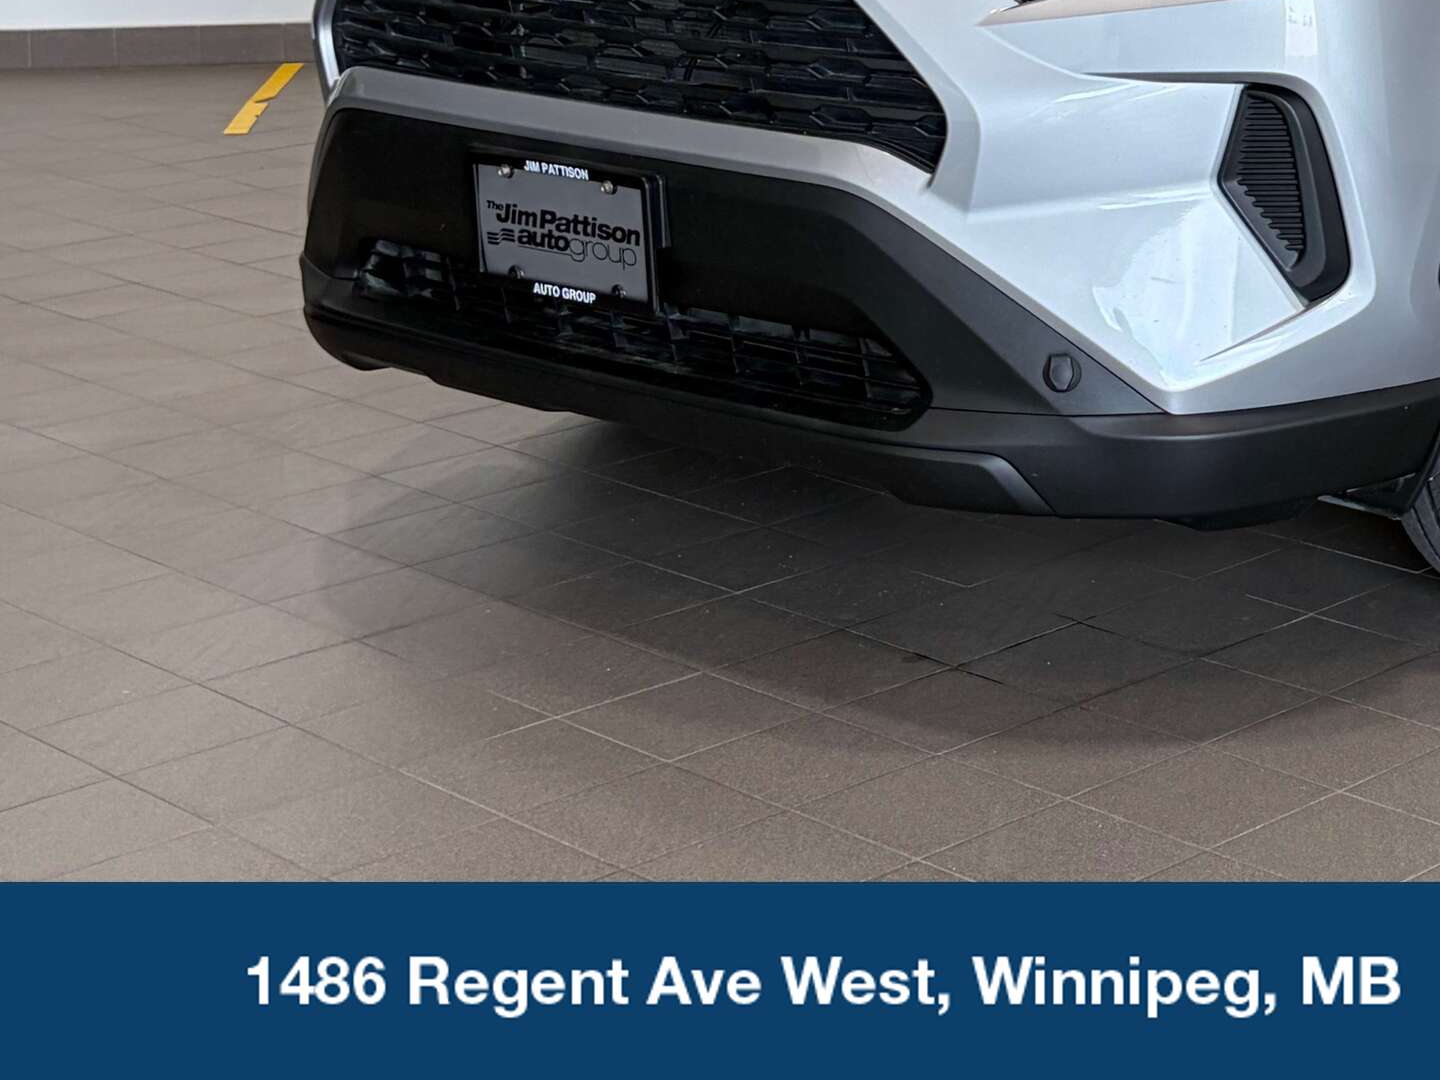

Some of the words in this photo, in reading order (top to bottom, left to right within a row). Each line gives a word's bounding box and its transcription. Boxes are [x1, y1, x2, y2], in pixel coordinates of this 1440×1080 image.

[523, 159, 541, 173] JIM
[541, 162, 590, 182] PATTISON
[486, 200, 504, 211] The
[532, 282, 561, 299] AUTO
[561, 288, 597, 304] GROUP
